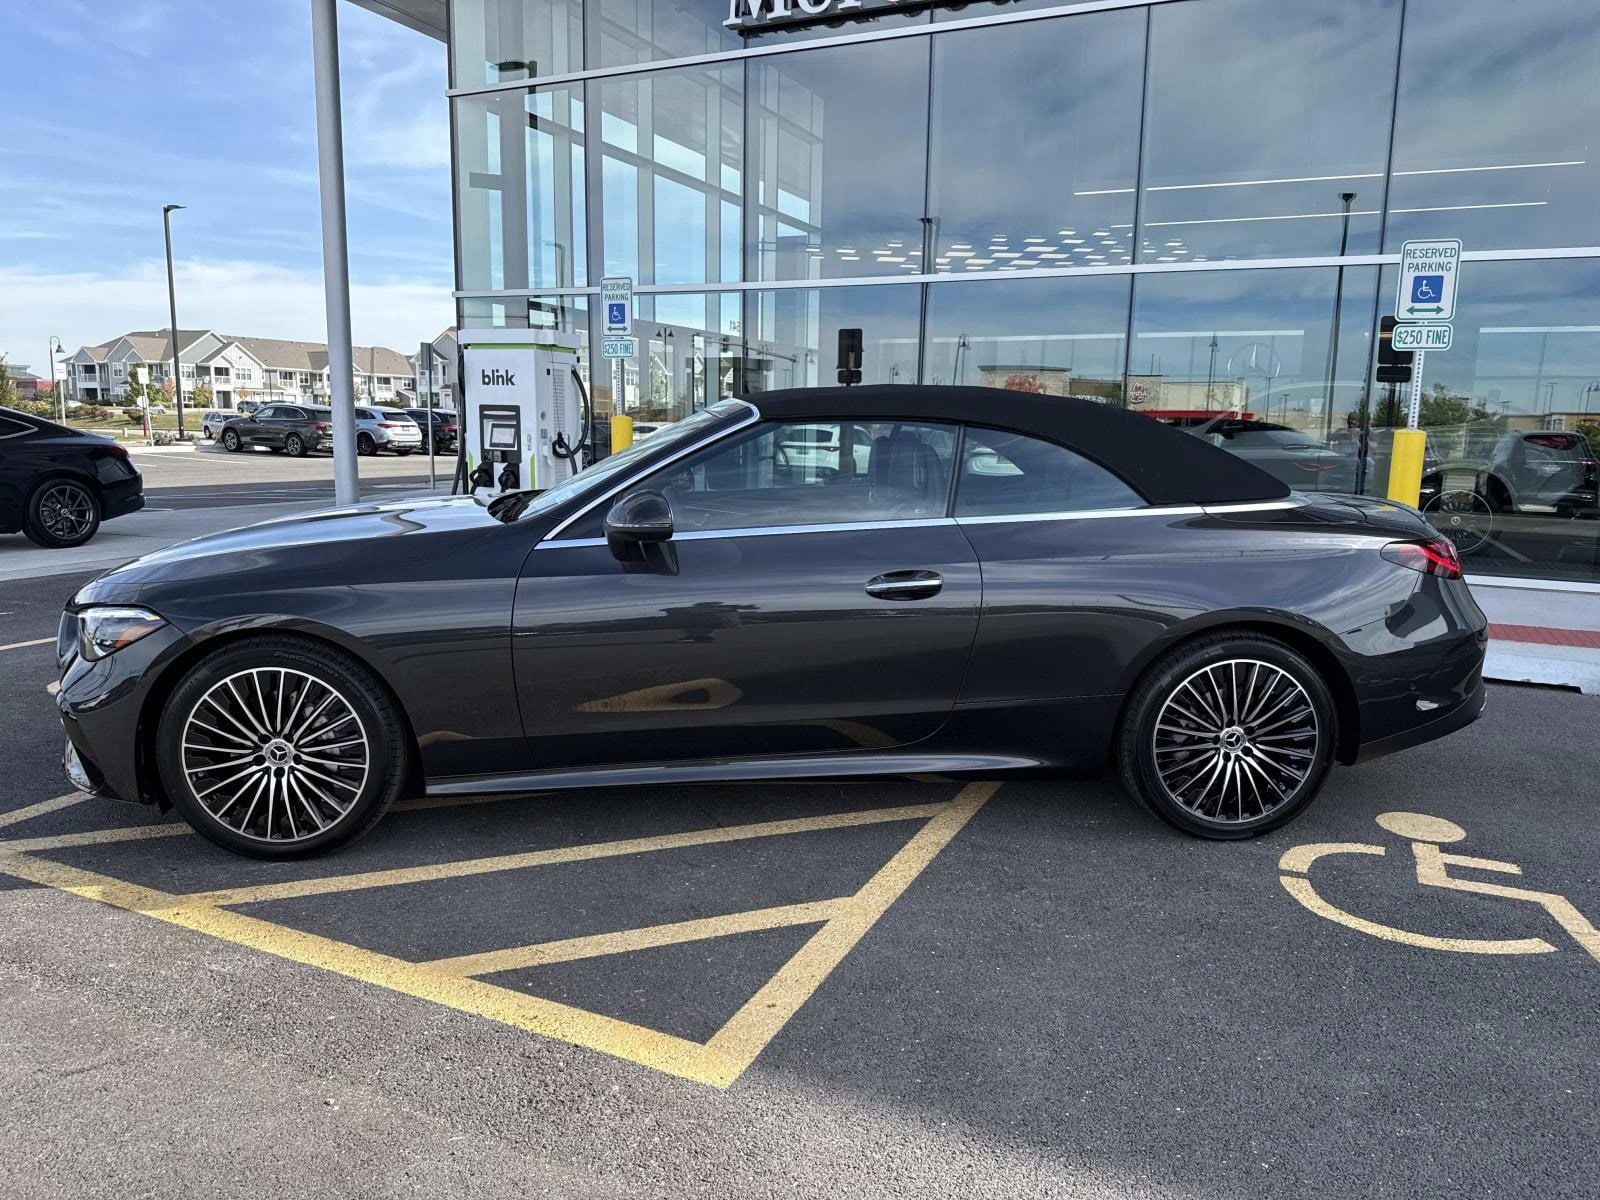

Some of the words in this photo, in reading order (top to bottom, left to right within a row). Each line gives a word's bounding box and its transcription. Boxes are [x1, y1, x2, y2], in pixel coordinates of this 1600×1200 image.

[1405, 248, 1457, 259] RESERVED
[1407, 262, 1452, 272] PARKING
[602, 283, 631, 291] RESERVED
[604, 293, 629, 301] PARKING
[1397, 330, 1423, 344] $250
[1425, 330, 1448, 344] FINE
[604, 343, 618, 354] $250
[620, 343, 632, 354] FINE
[481, 369, 516, 386] blink
